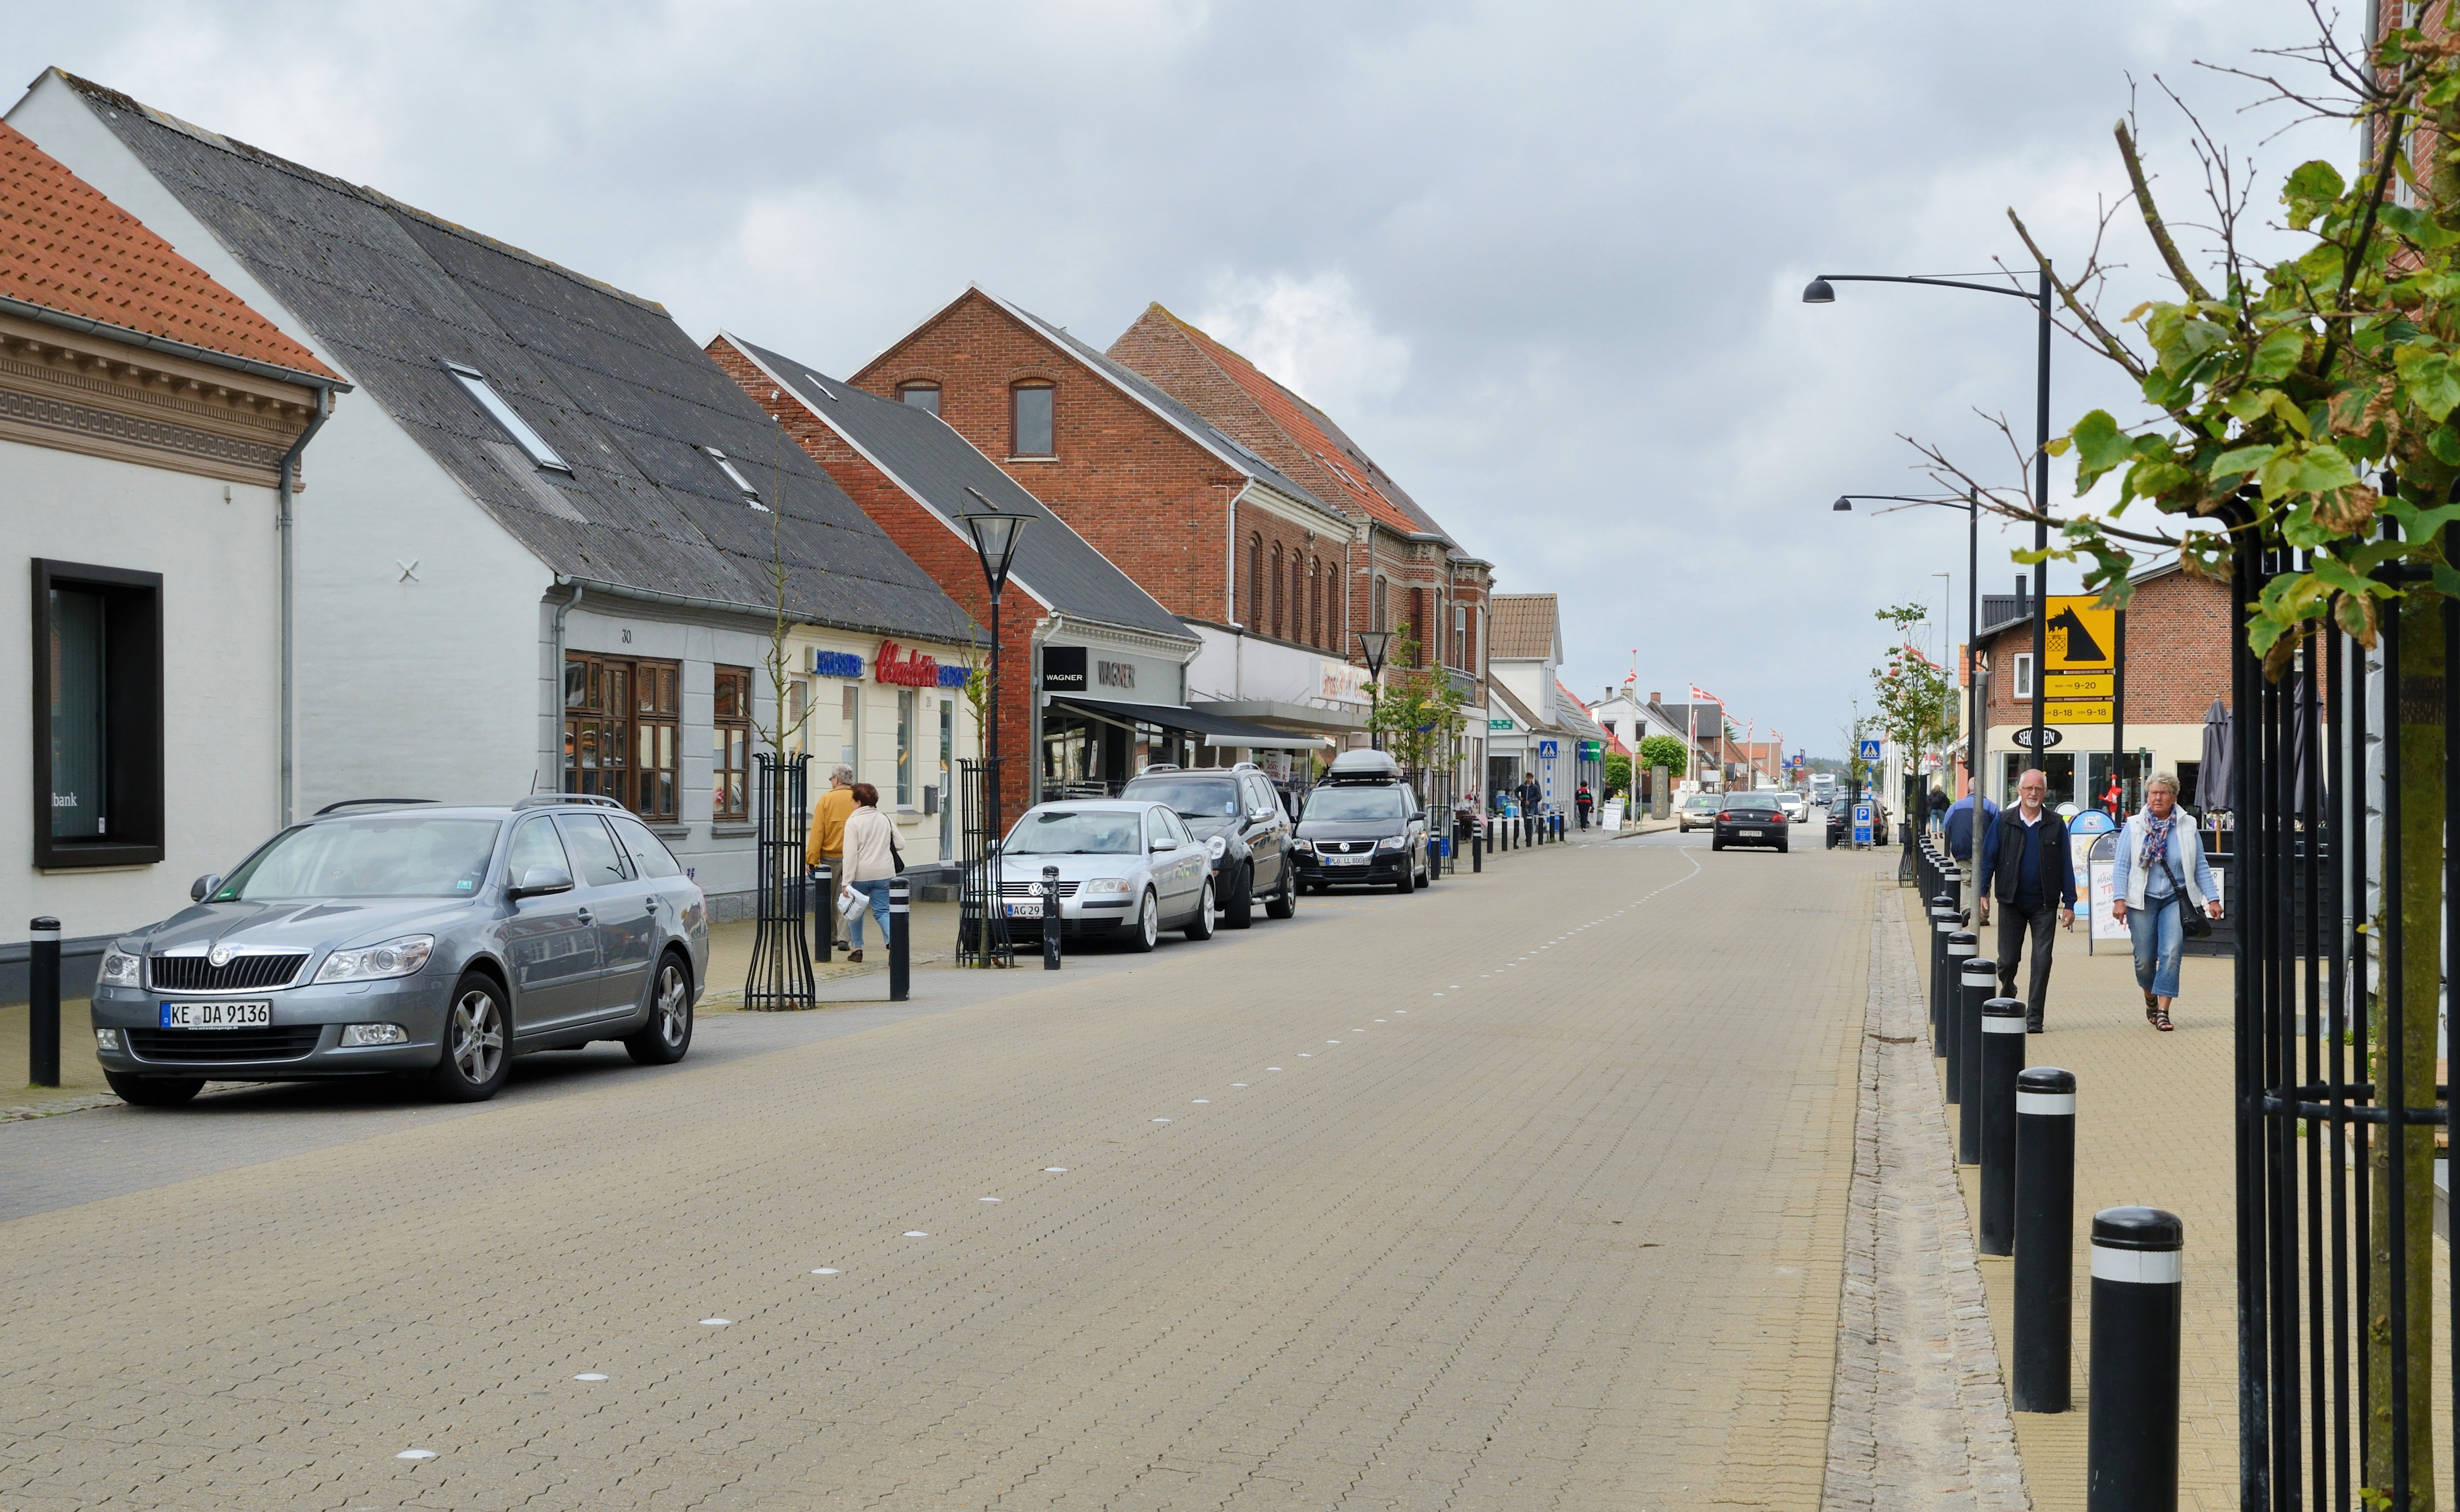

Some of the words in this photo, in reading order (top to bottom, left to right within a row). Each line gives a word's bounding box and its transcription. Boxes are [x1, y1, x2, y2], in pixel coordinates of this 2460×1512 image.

[622, 629, 631, 644] 30
[1098, 660, 1135, 689] WAGNER
[52, 792, 78, 806] bank
[1014, 906, 1026, 914] AG
[172, 1006, 190, 1024] KE
[203, 1006, 222, 1023] DA
[227, 1005, 267, 1023] 9136
